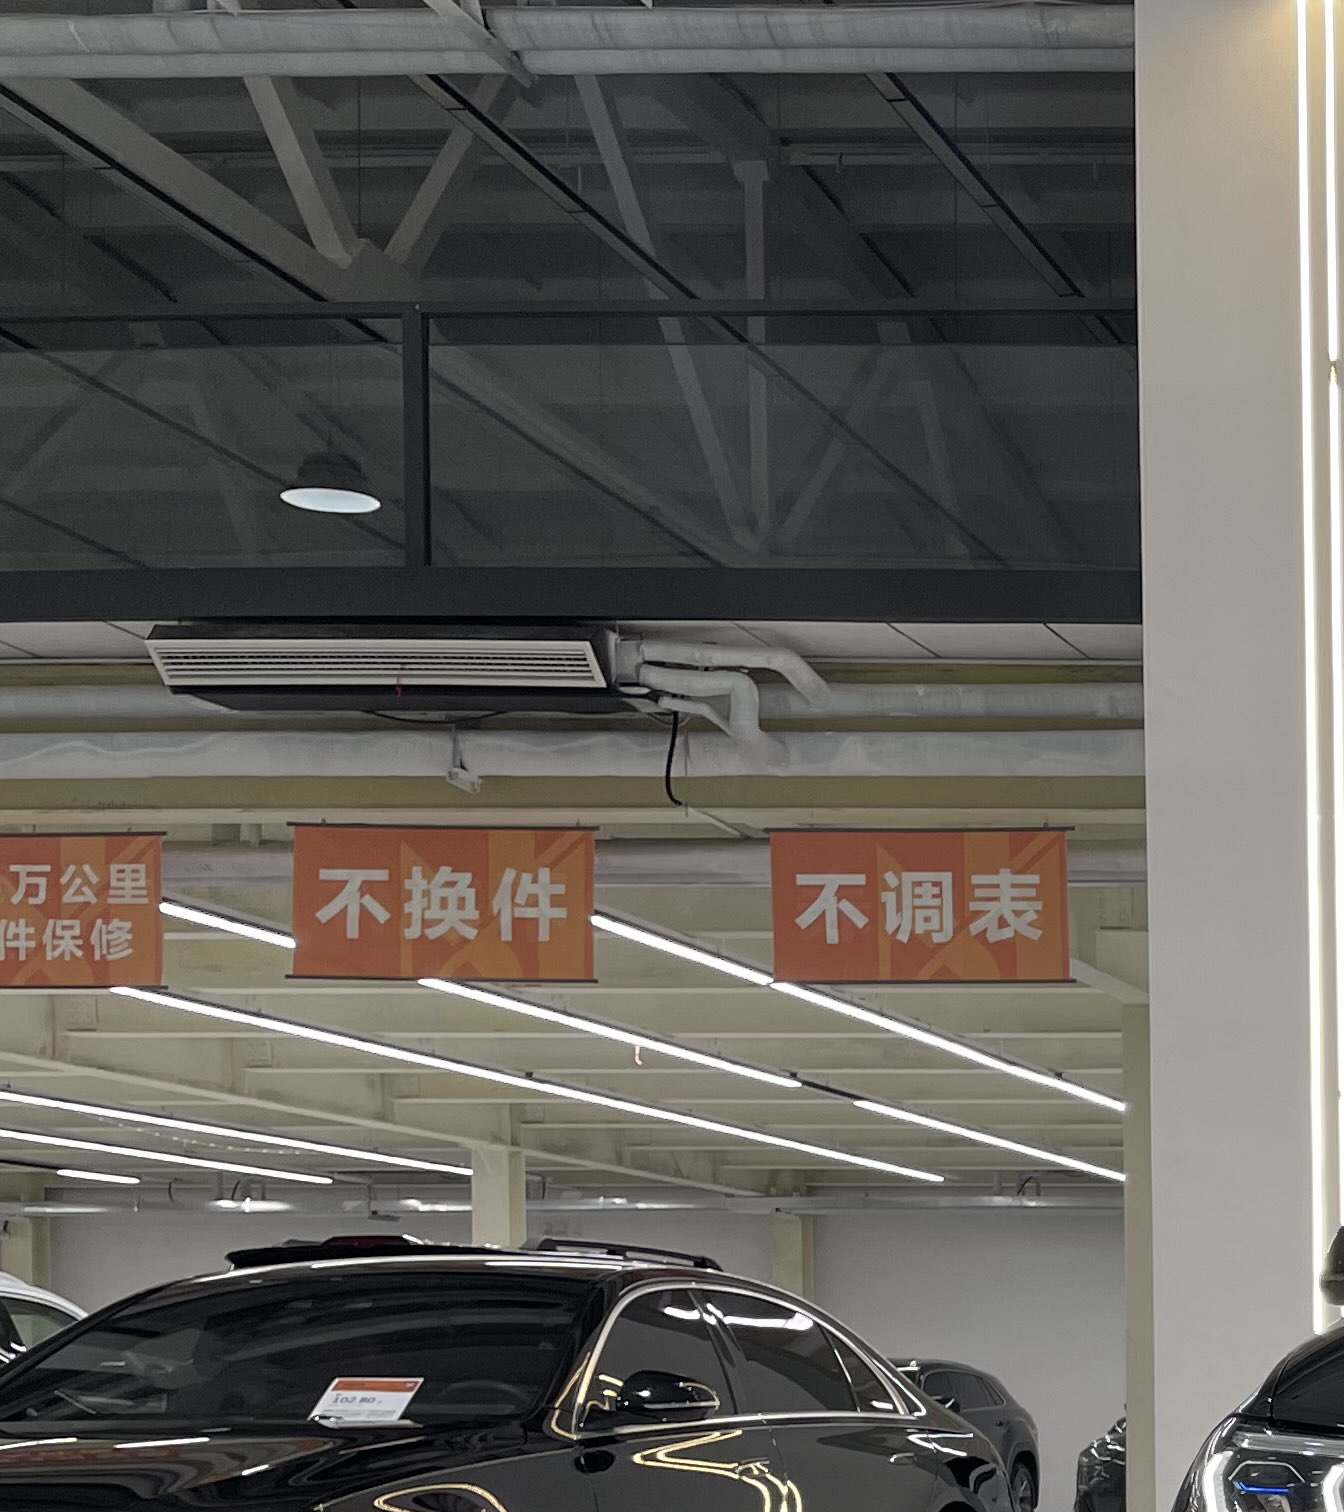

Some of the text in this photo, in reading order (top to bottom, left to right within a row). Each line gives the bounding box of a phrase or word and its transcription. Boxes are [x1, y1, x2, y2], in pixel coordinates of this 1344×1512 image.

[9, 863, 149, 906] 万公里
[314, 866, 567, 942] 不换件
[794, 868, 1044, 945] 不调表
